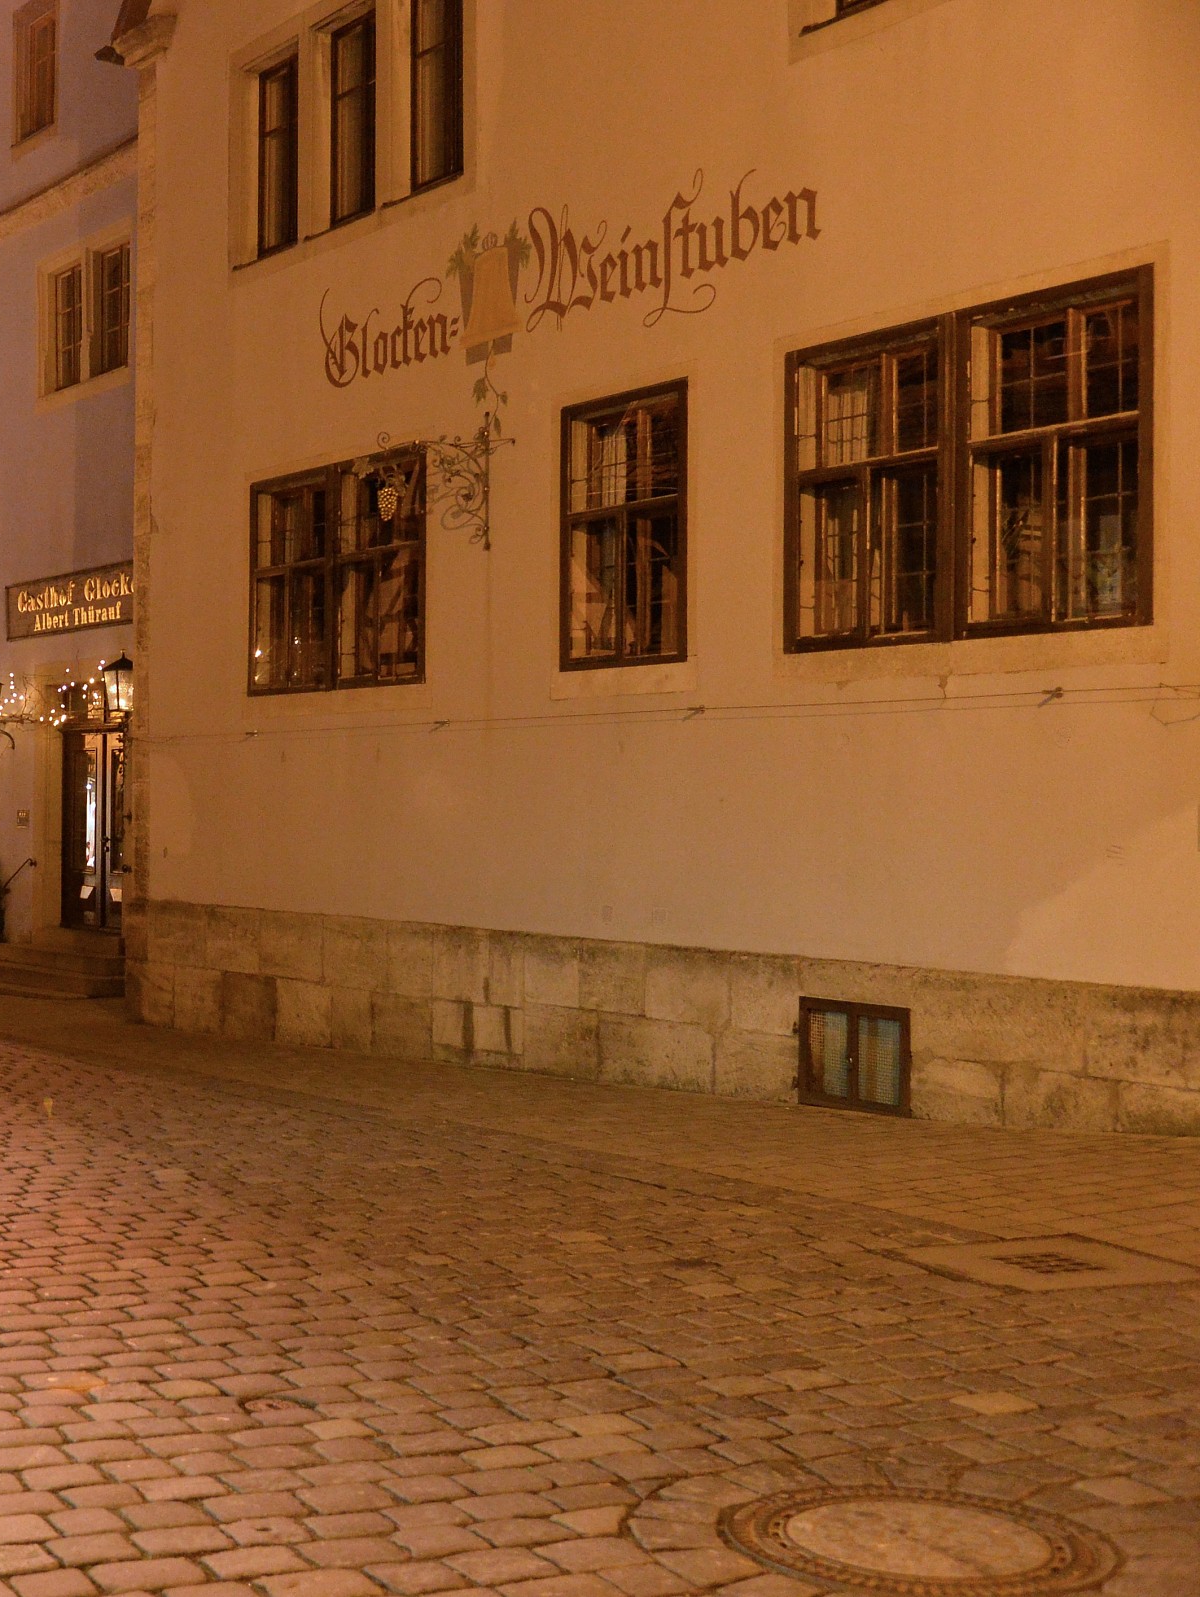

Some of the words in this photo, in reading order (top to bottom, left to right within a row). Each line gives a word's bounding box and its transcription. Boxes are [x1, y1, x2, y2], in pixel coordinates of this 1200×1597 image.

[17, 580, 76, 614] Gasthof
[33, 609, 70, 632] Albert
[72, 600, 122, 626] Thürauf
